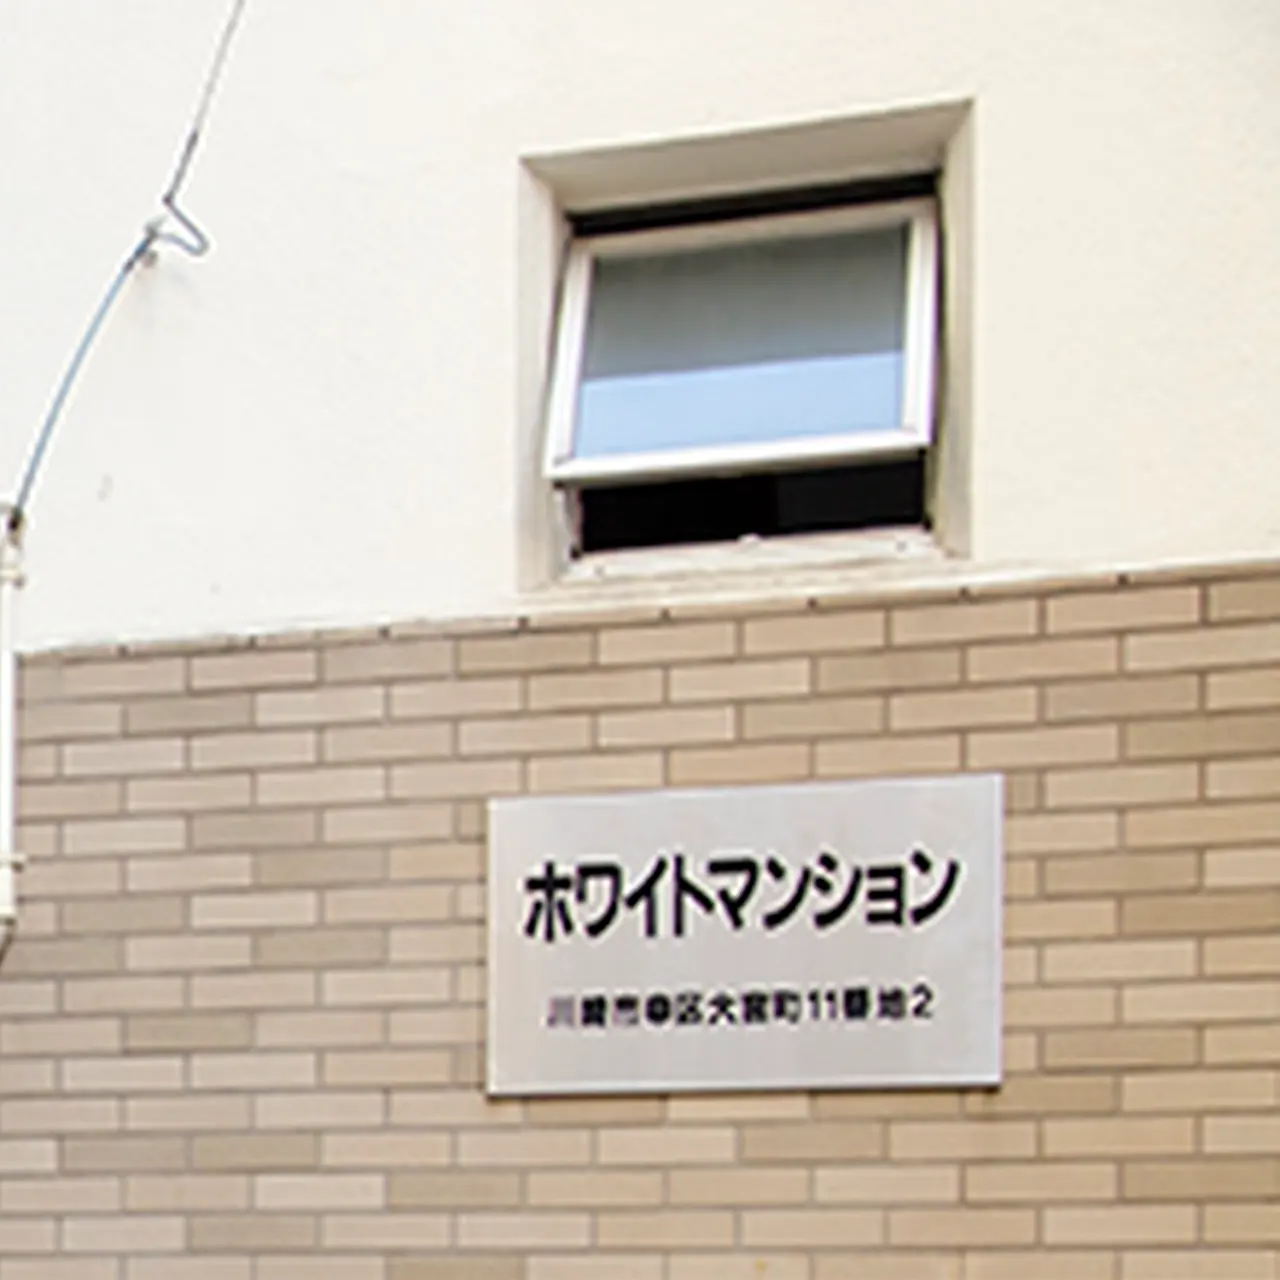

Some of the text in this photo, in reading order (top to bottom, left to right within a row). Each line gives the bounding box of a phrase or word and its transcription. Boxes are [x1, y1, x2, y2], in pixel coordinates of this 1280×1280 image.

[524, 850, 960, 944] ホワイトマンション
